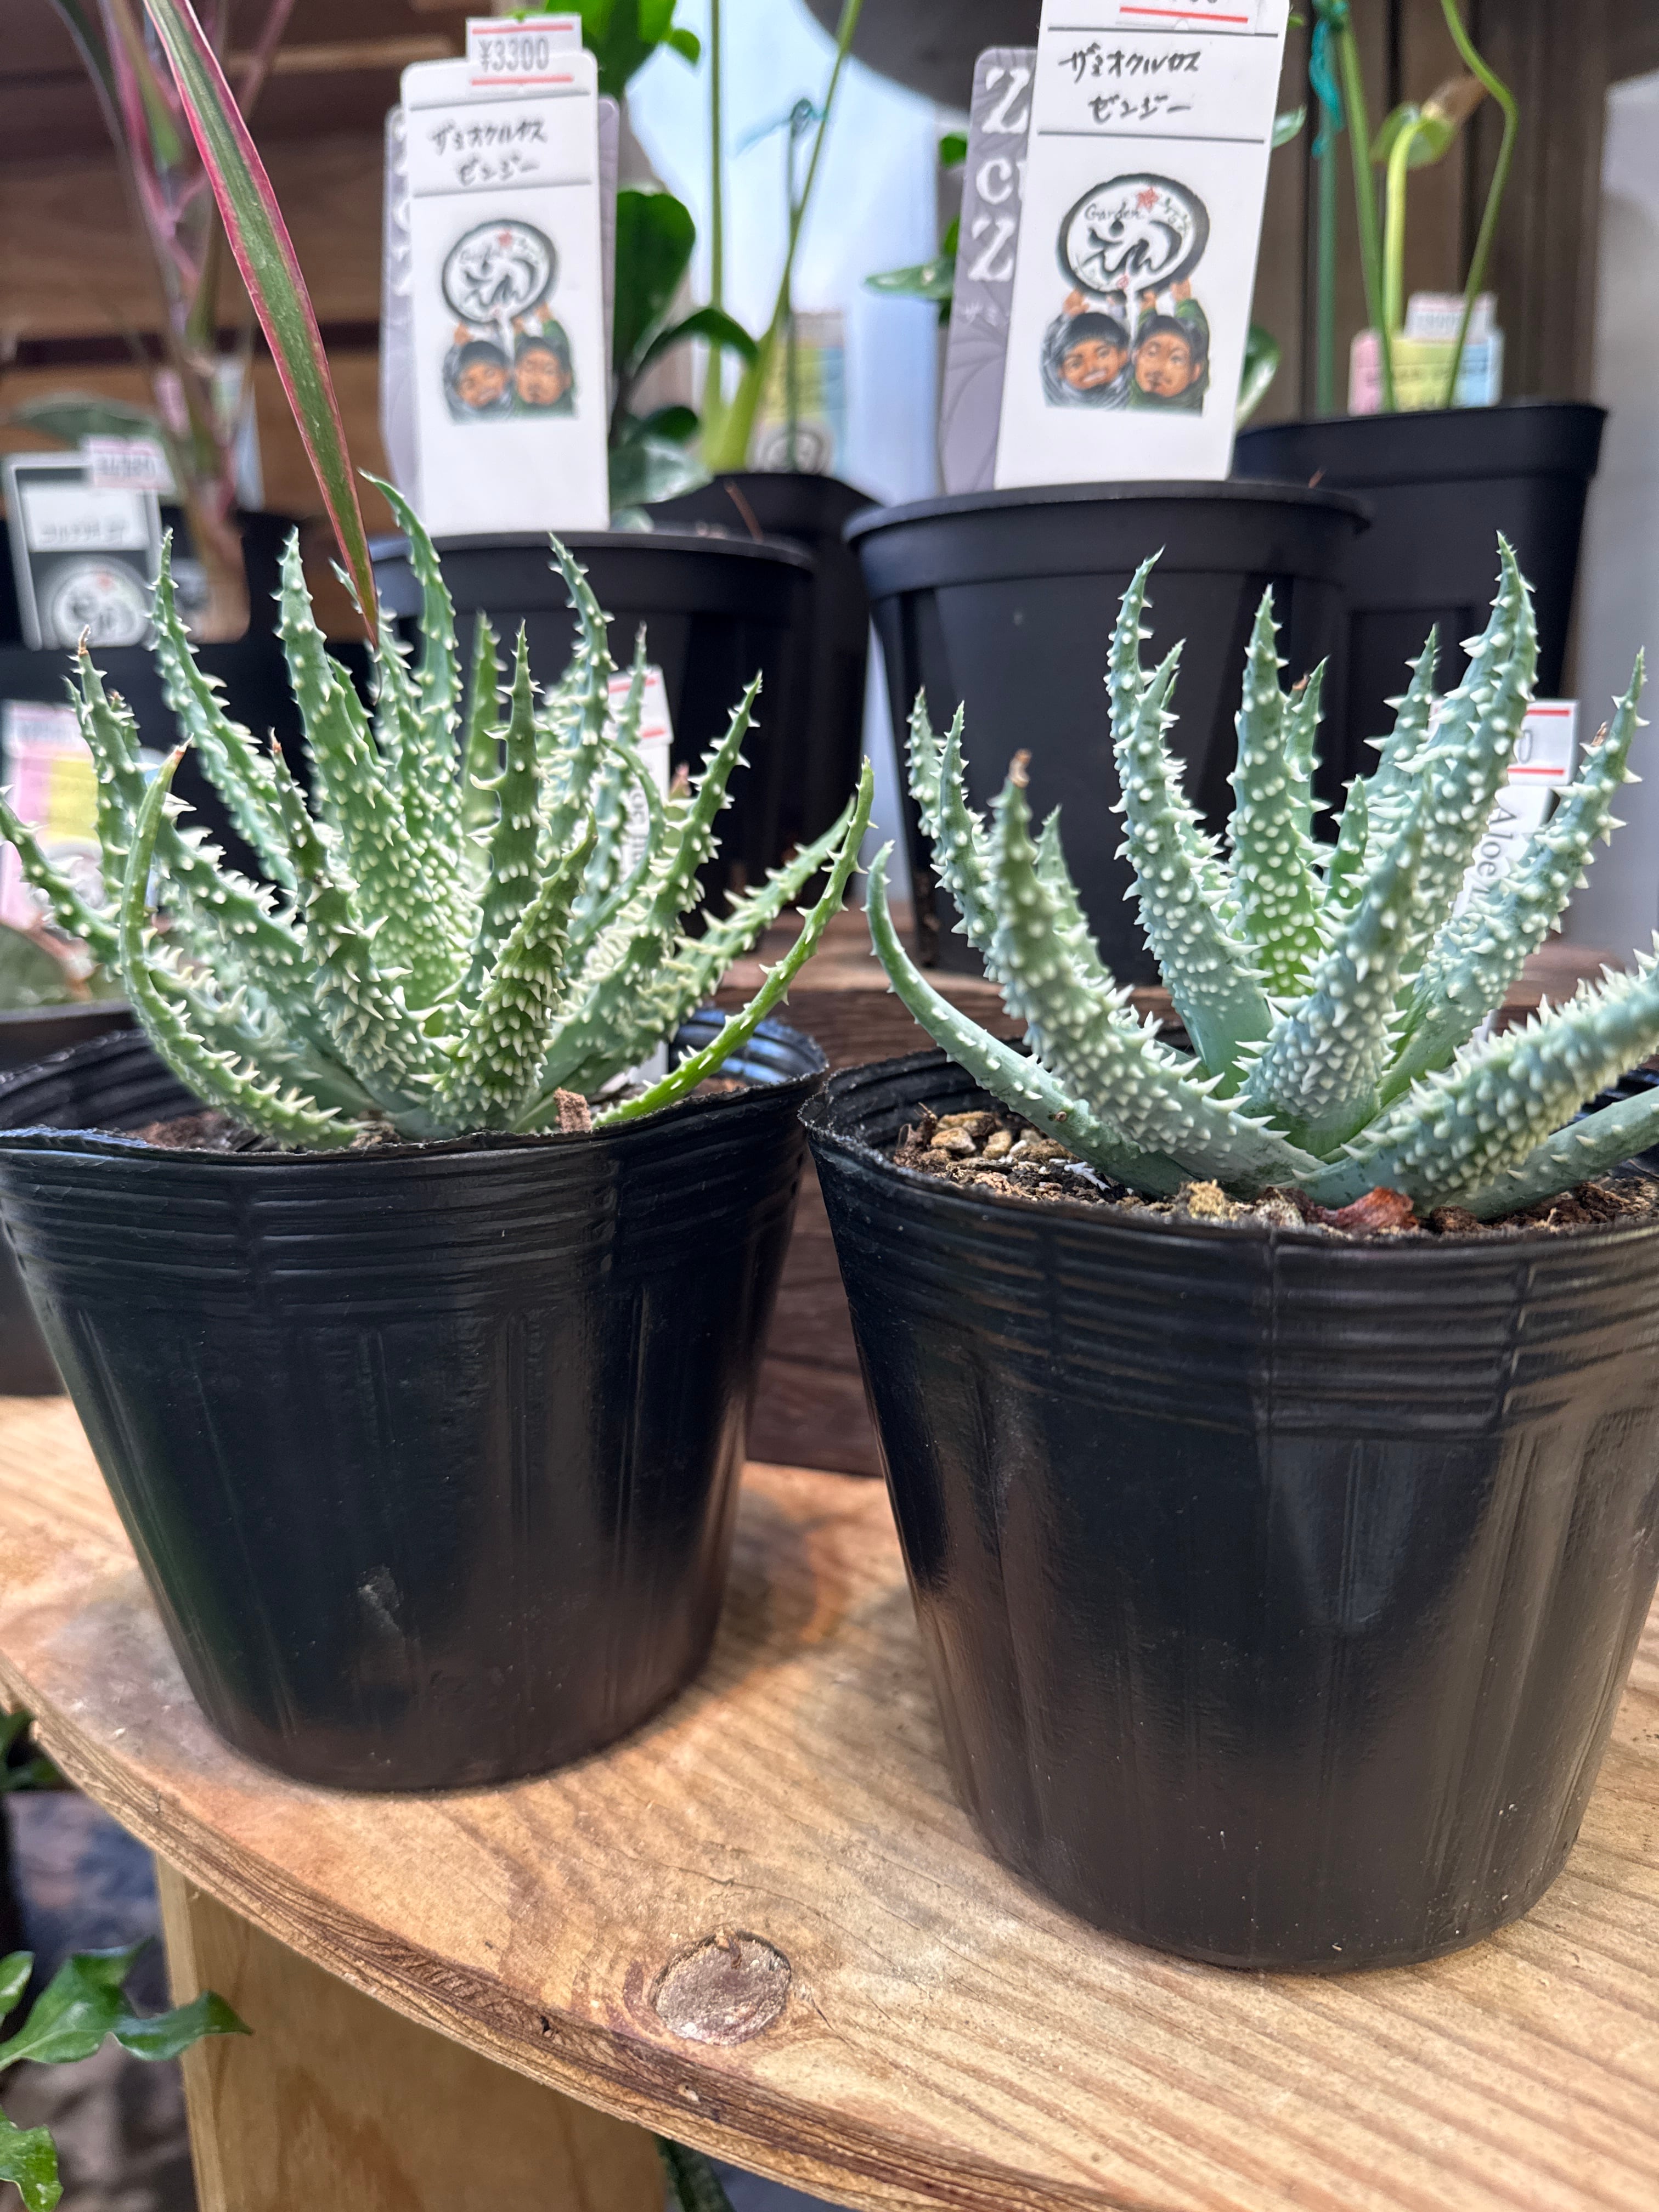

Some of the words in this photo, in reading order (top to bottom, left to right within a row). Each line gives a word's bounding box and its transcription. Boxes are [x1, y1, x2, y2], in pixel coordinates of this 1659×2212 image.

[478, 38, 549, 72] ¥3300
[1084, 201, 1140, 221] Garden
[1477, 807, 1517, 876] Aloe
